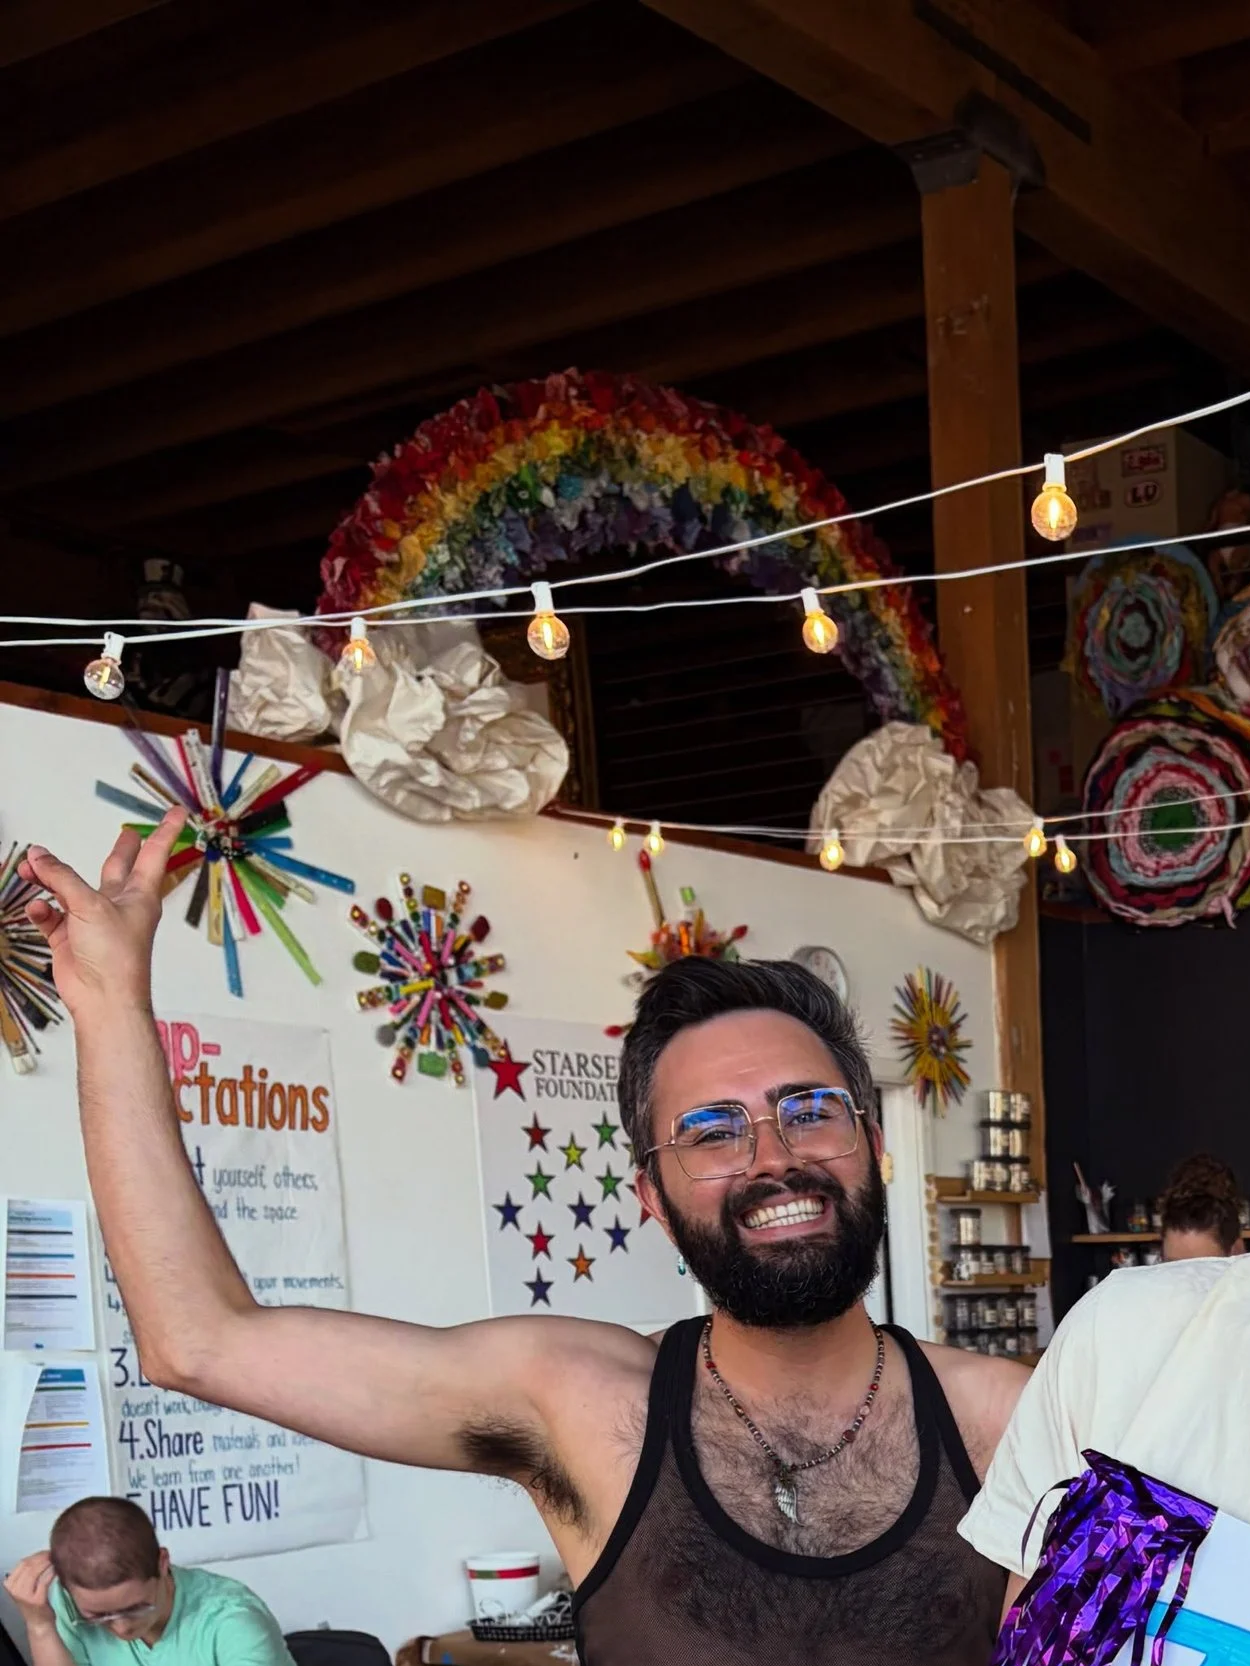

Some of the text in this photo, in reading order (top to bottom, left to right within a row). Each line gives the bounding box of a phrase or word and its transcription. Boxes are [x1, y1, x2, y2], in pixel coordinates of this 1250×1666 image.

[155, 1020, 221, 1080] p-
[532, 1049, 621, 1080] STARSE
[236, 1195, 257, 1221] the
[263, 1205, 298, 1222] space
[267, 1430, 286, 1448] and
[128, 1454, 301, 1490] We learn from one another!
[222, 1479, 280, 1525] FUN!
